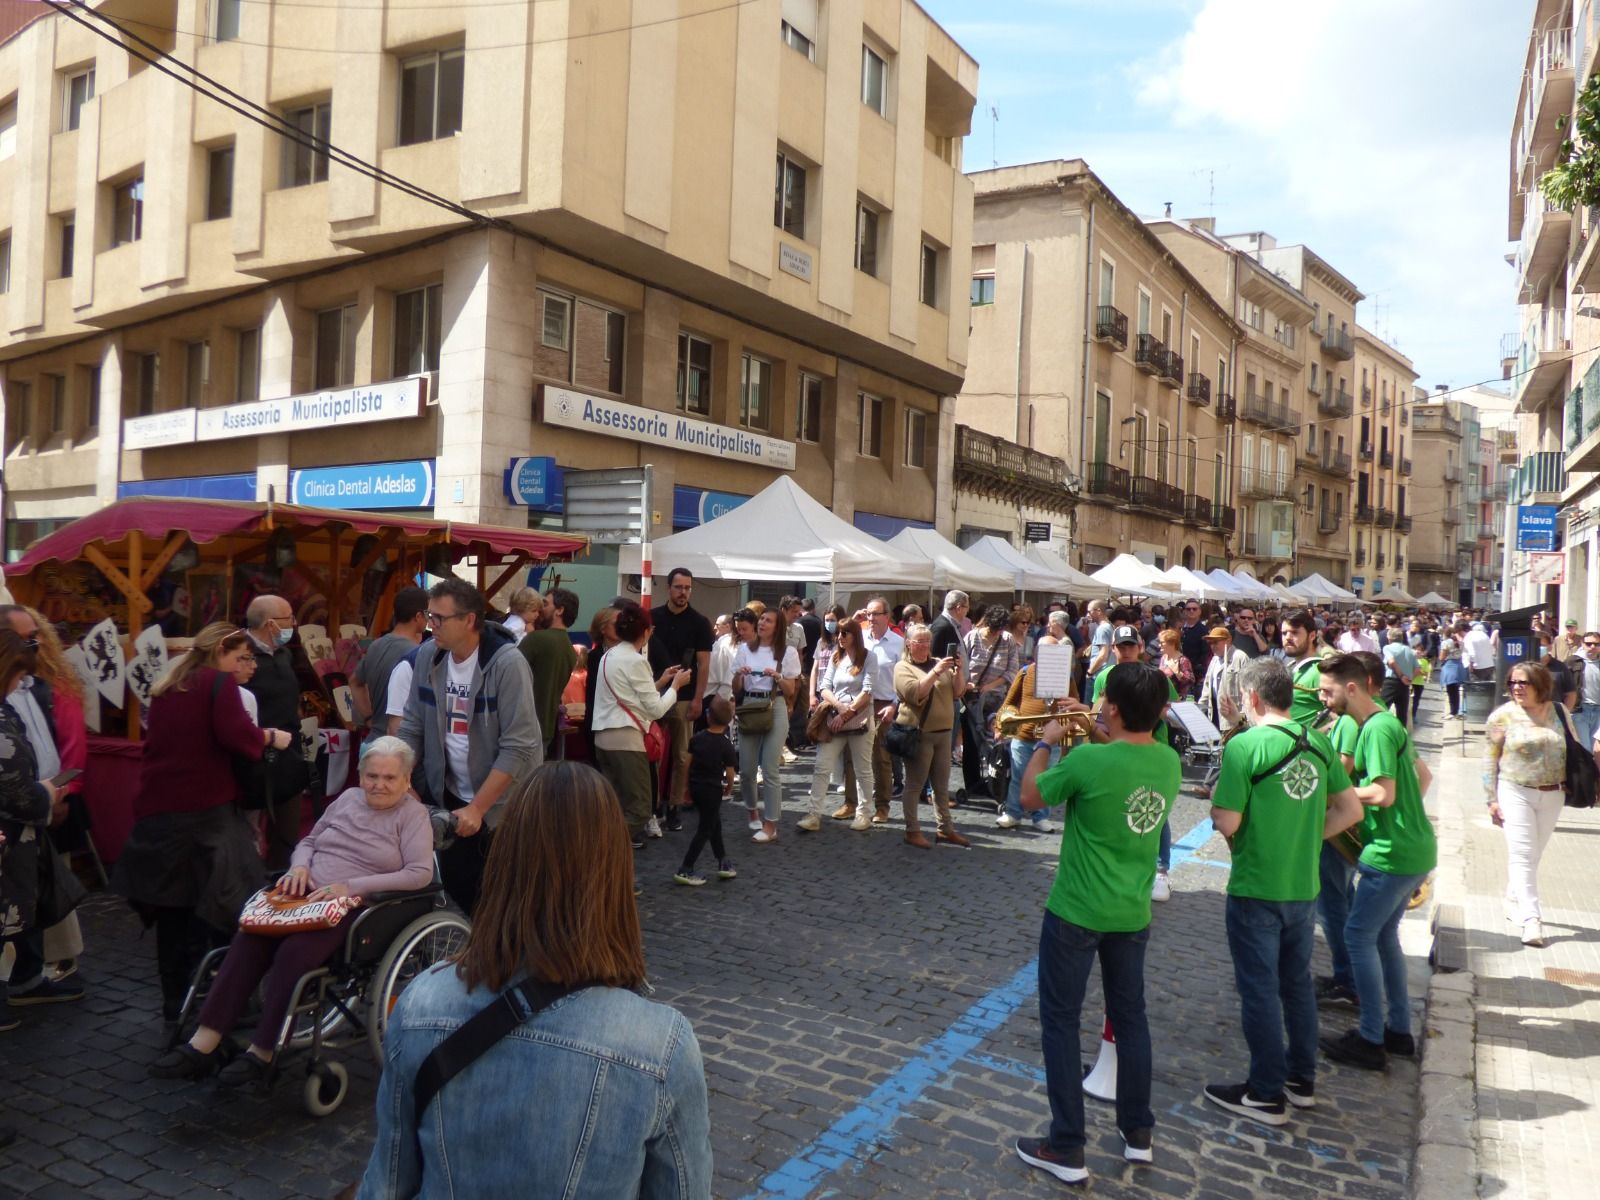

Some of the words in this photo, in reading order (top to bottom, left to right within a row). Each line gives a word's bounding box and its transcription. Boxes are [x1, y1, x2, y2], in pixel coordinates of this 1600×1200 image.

[222, 406, 281, 429] Assessoria
[291, 390, 383, 423] Municipalista
[582, 399, 668, 438] Assessoria
[675, 419, 762, 457] Municipalista
[338, 476, 372, 496] Dental
[374, 473, 416, 494] Adeslas
[520, 477, 541, 485] Dental
[520, 486, 544, 494] Adeslas
[1522, 515, 1553, 525] blava
[1507, 642, 1522, 656] 118
